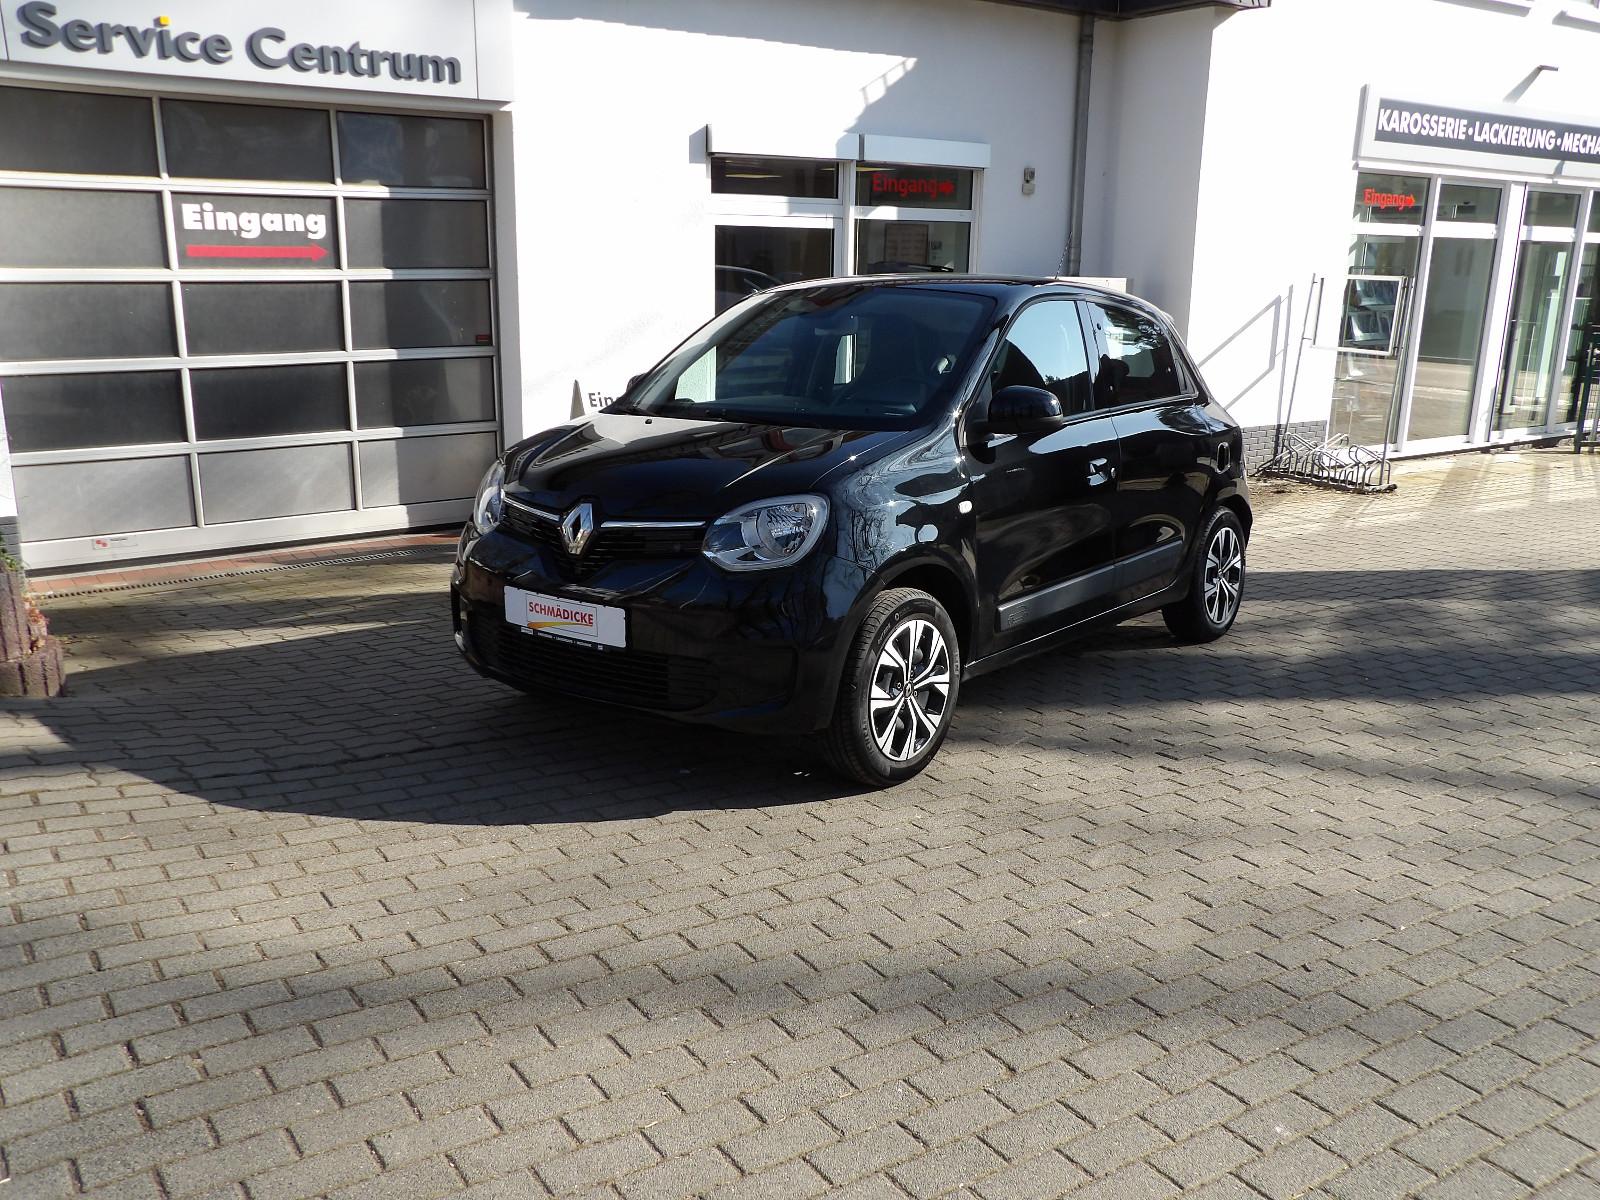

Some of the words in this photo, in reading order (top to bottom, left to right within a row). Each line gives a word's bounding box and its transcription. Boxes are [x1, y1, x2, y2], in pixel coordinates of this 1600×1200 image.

[17, 1, 233, 65] Service
[245, 27, 462, 84] Centrum
[1378, 108, 1467, 140] KAROSSERIE
[1474, 121, 1556, 150] LACKIERUNG
[872, 173, 938, 199] Eingang
[1363, 187, 1406, 210] Eingang
[181, 202, 327, 239] Eingang
[588, 391, 620, 407] Ein
[528, 601, 593, 625] SCHMÄDICKE
